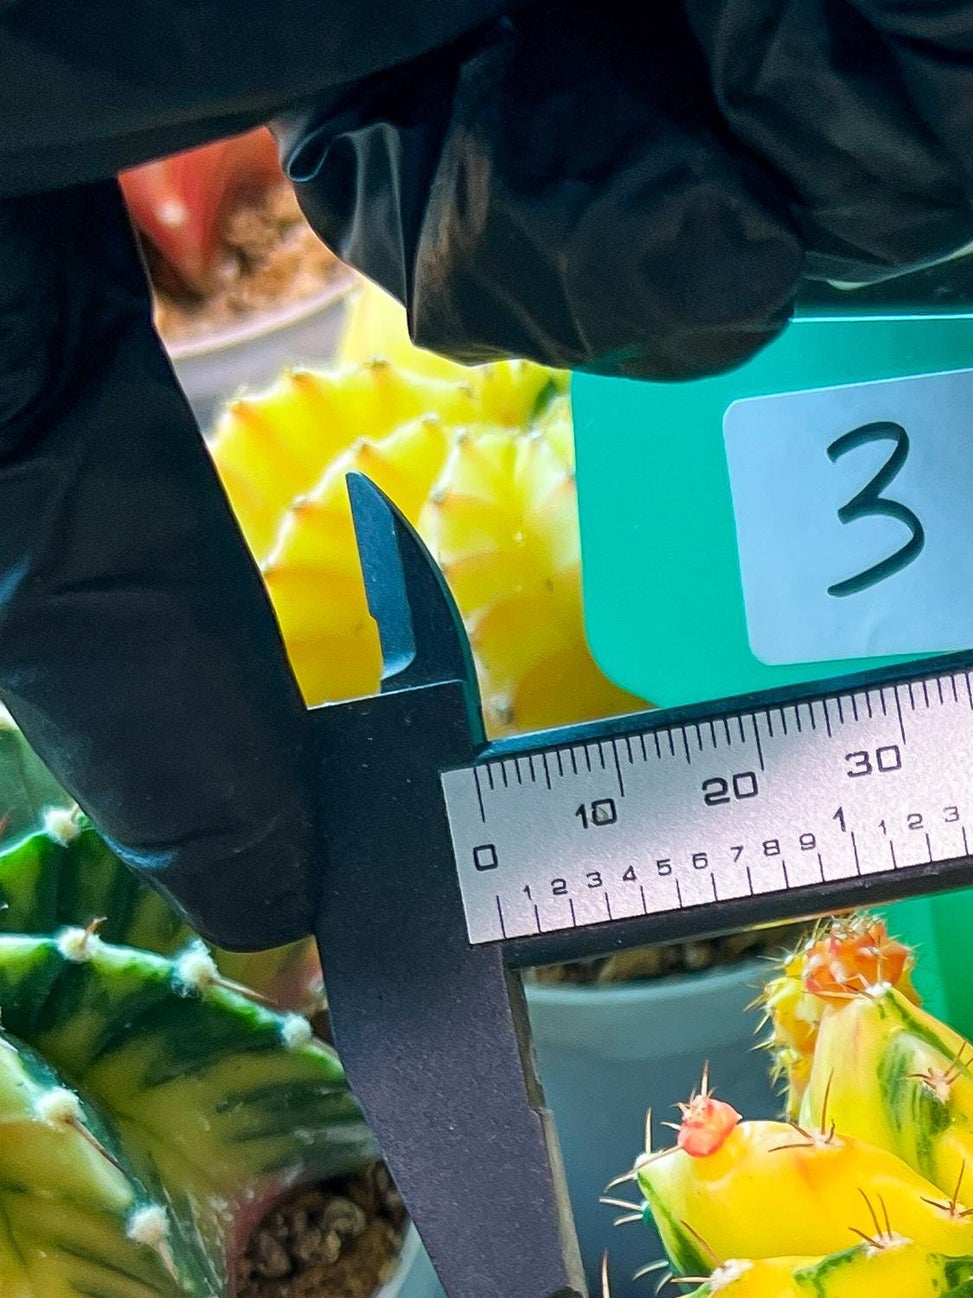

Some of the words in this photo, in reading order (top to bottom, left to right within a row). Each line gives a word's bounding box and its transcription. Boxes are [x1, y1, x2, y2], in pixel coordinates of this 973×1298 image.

[826, 421, 925, 598] 3
[473, 844, 499, 871] 0
[575, 798, 618, 829] 10
[701, 771, 758, 805] 20
[845, 745, 901, 777] 30
[523, 885, 532, 899] 1
[551, 879, 568, 895] 2
[586, 872, 603, 888] 3
[622, 866, 637, 882] 4
[657, 859, 673, 875] 5
[692, 853, 709, 869] 6
[730, 846, 744, 862] 7
[762, 839, 780, 856] 8
[799, 833, 817, 850] 9
[833, 807, 848, 832] 1
[879, 820, 888, 834] 1
[907, 813, 923, 830] 2
[943, 806, 959, 822] 3
